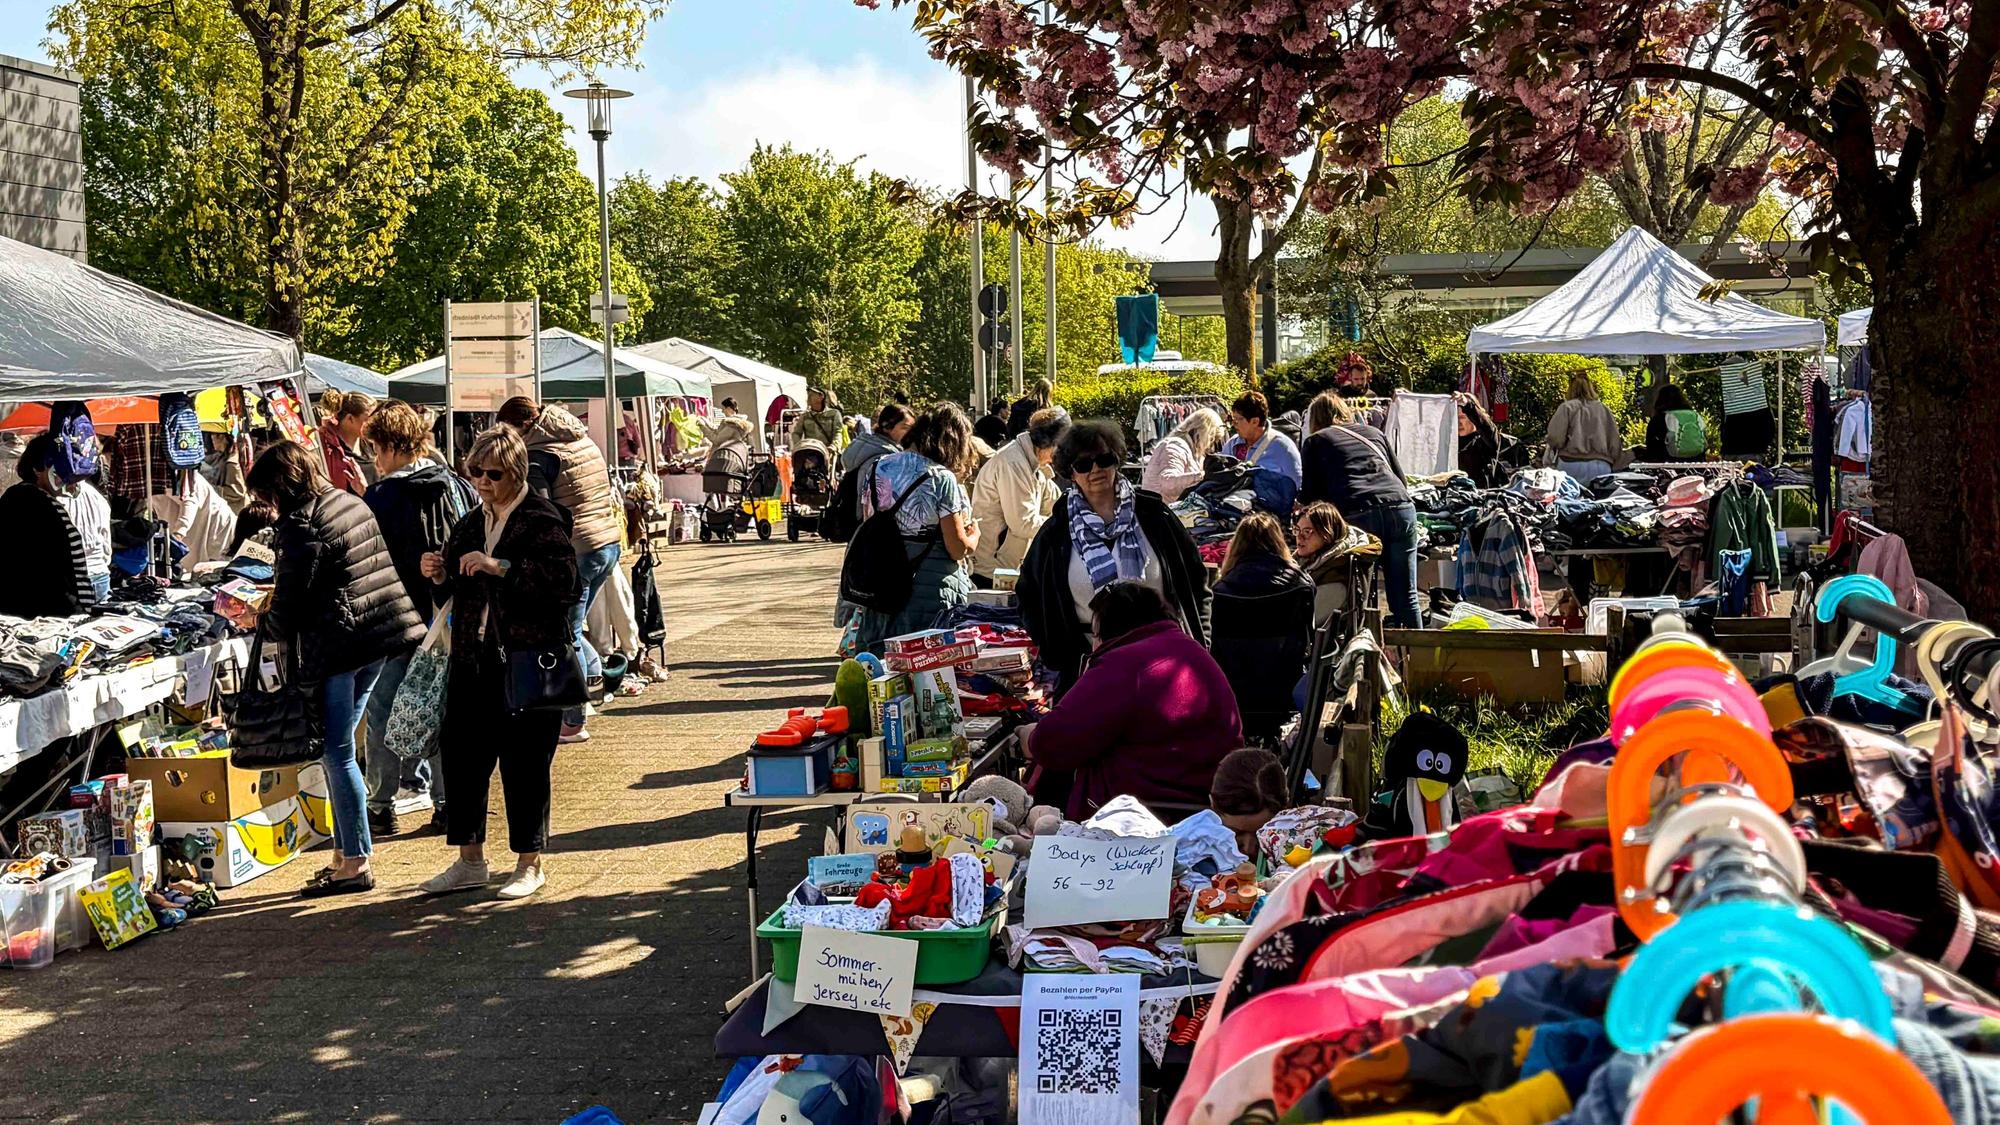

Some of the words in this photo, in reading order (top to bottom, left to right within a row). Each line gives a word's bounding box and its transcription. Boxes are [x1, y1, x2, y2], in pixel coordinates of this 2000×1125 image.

[1048, 844, 1096, 868] Bodys
[825, 867, 863, 877] Fahrzeuge
[1052, 876, 1072, 890] 56
[1040, 986, 1078, 994] Bezahlen
[1079, 988, 1093, 996] per
[1095, 986, 1123, 995] PayPal
